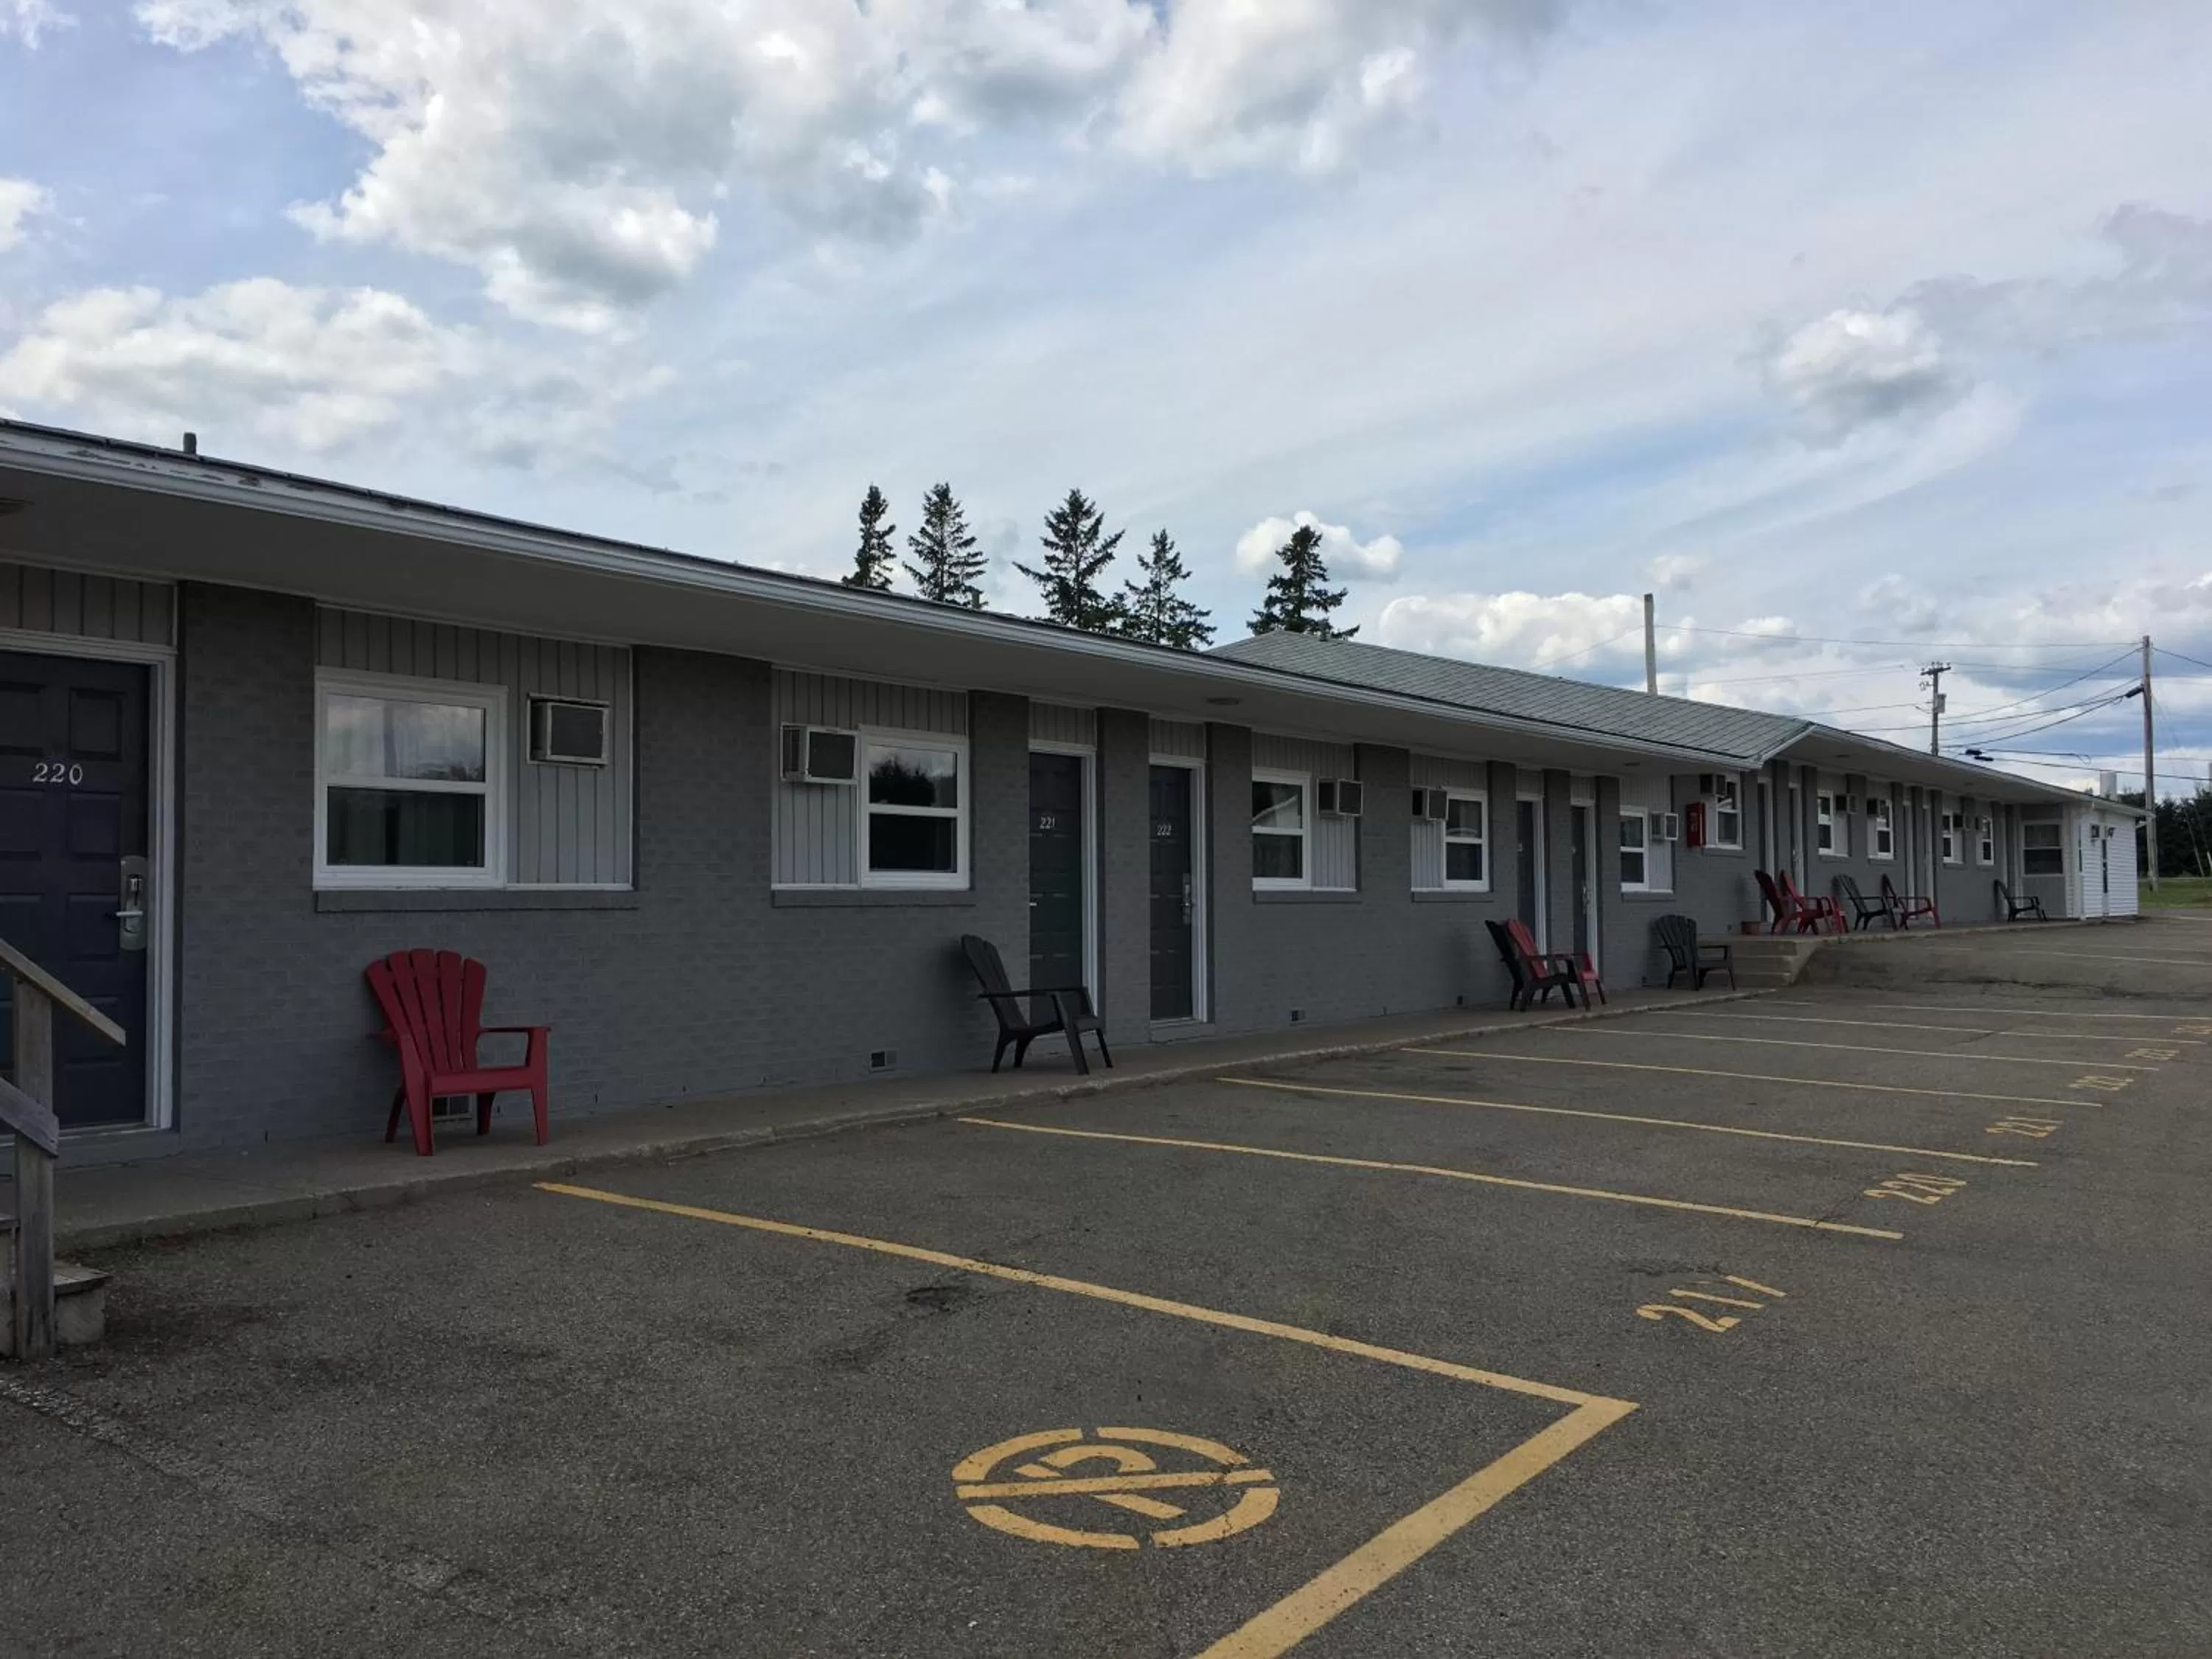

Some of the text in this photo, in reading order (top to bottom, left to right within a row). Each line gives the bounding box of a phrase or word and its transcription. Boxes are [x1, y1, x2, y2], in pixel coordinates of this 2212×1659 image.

[32, 762, 83, 785] 220
[1040, 816, 1056, 830] 221
[1983, 1115, 2065, 1139] 221
[1863, 1173, 1968, 1206] 220
